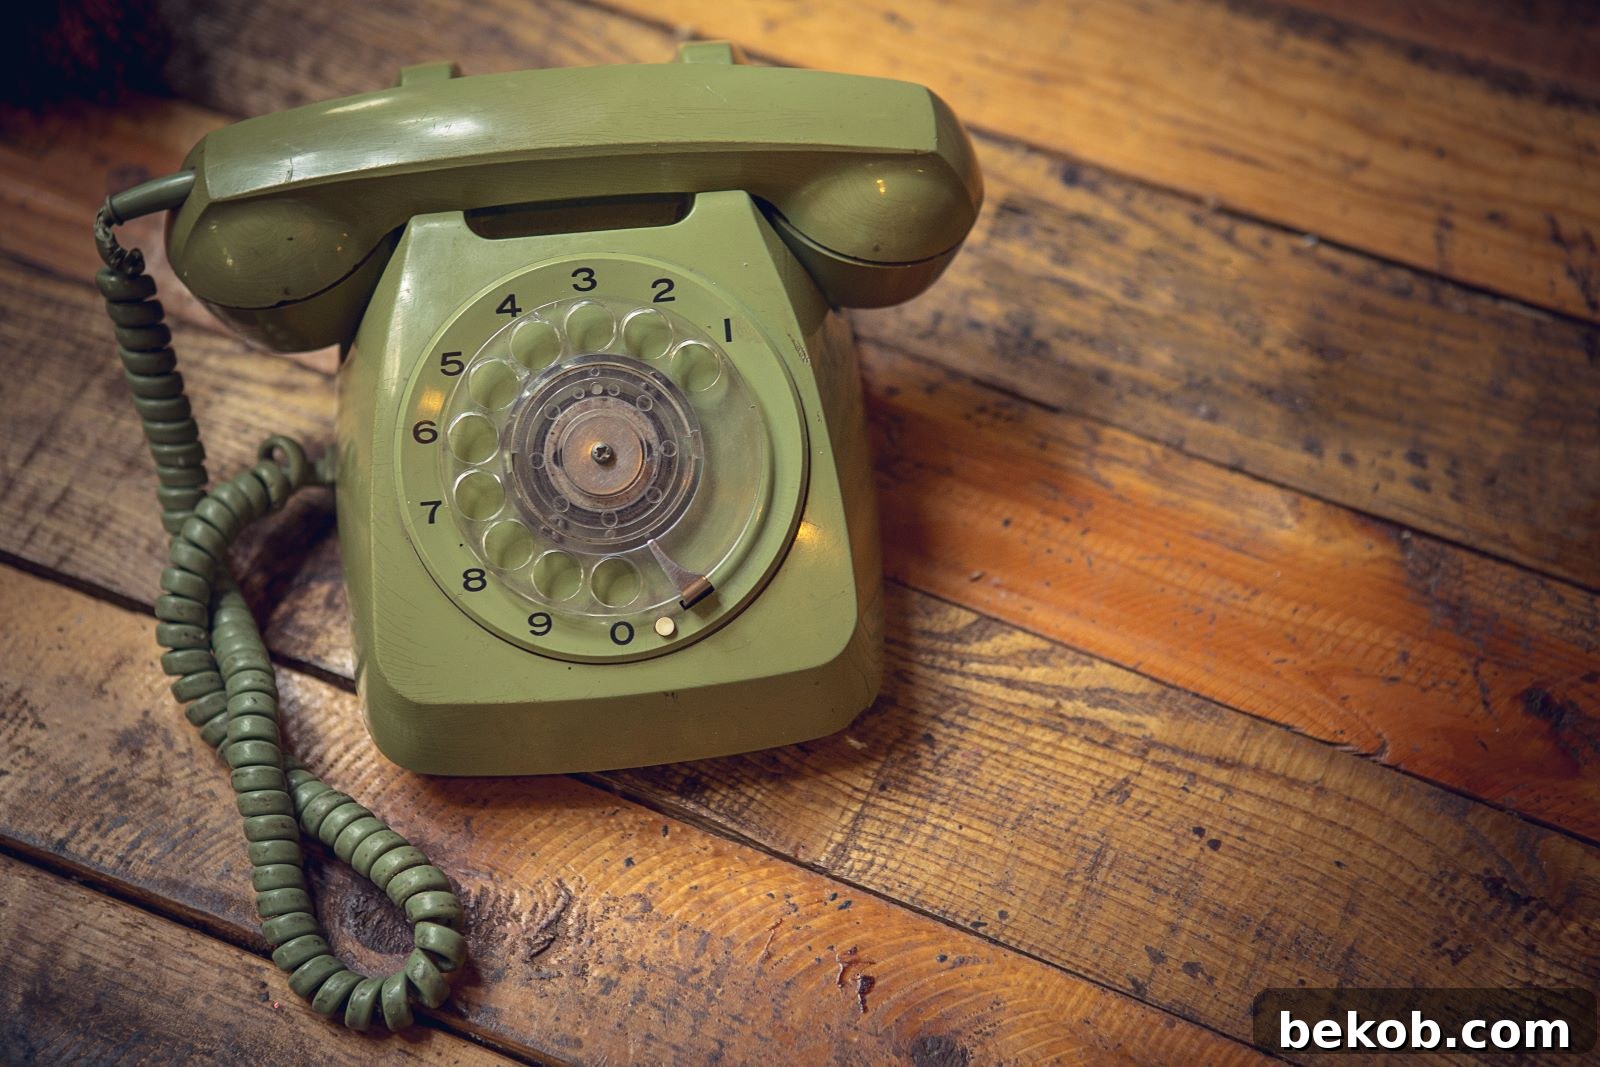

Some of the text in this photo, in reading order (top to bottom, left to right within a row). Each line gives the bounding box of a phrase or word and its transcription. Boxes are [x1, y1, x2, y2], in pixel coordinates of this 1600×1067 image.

[571, 267, 597, 291] 3
[651, 278, 675, 302] 2
[496, 294, 521, 317] 4
[723, 318, 733, 342] 1
[441, 352, 464, 376] 5
[413, 421, 437, 444] 6
[420, 500, 441, 524] 7
[463, 569, 486, 592] 8
[528, 612, 552, 636] 9
[610, 622, 634, 645] 0
